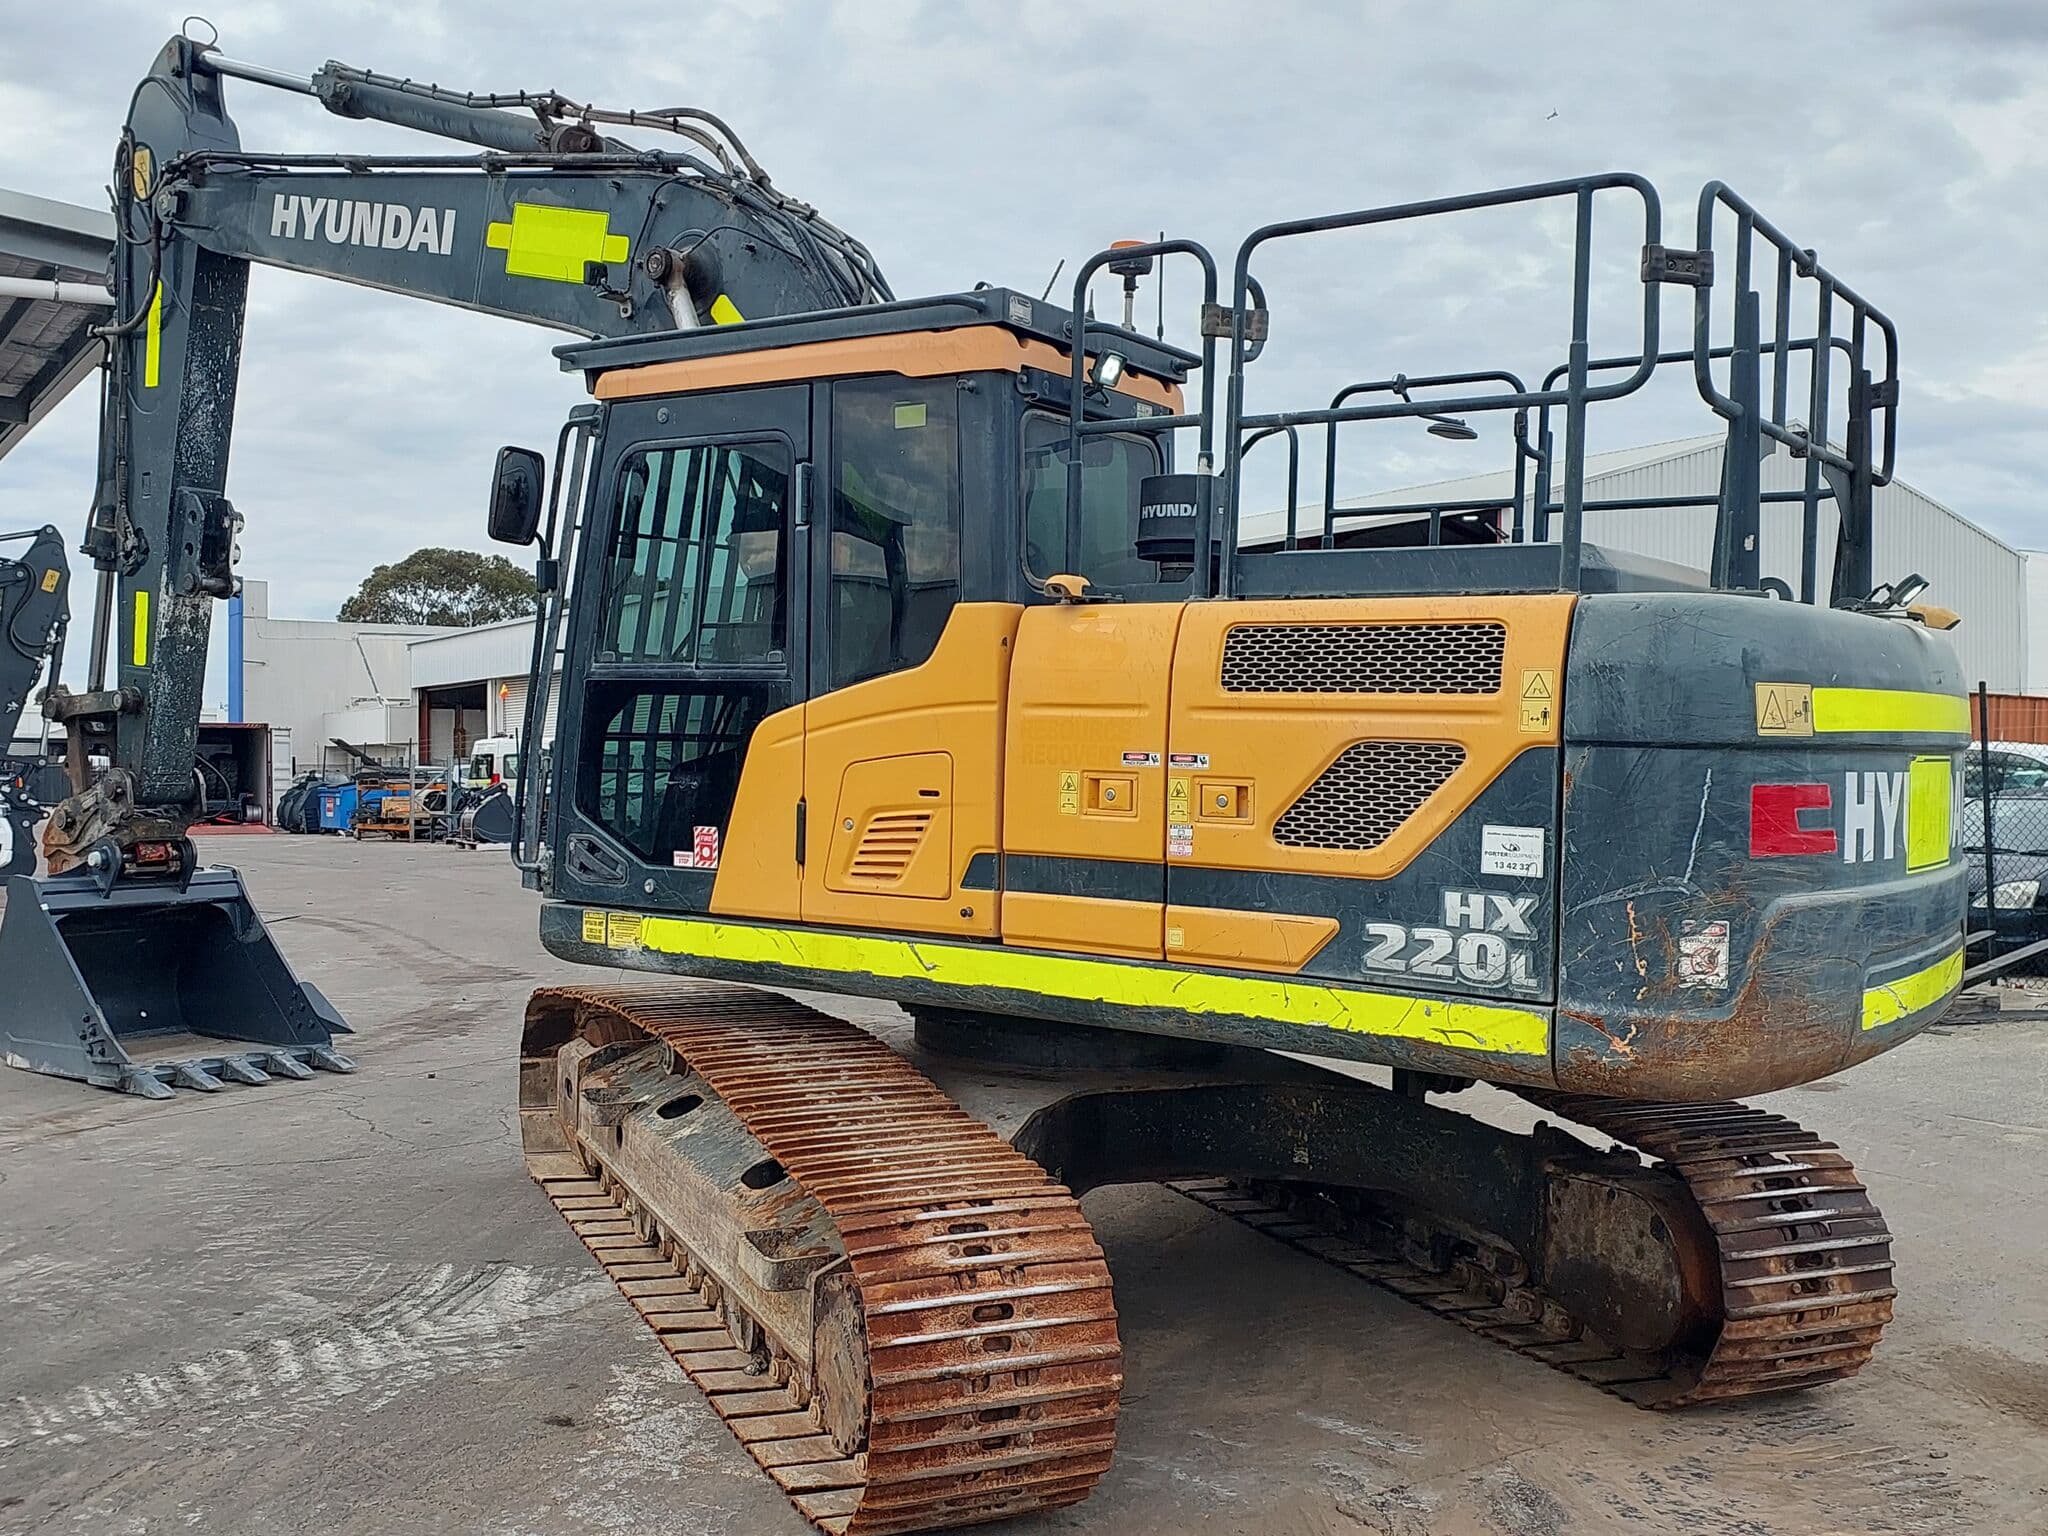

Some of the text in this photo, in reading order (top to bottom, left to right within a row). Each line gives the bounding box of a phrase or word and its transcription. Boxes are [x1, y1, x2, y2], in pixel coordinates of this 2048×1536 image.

[270, 193, 457, 256] HYUNDAI
[1141, 503, 1197, 520] HYUND
[1494, 861, 1505, 869] 13
[1506, 862, 1517, 871] 42
[1444, 890, 1534, 935] HX
